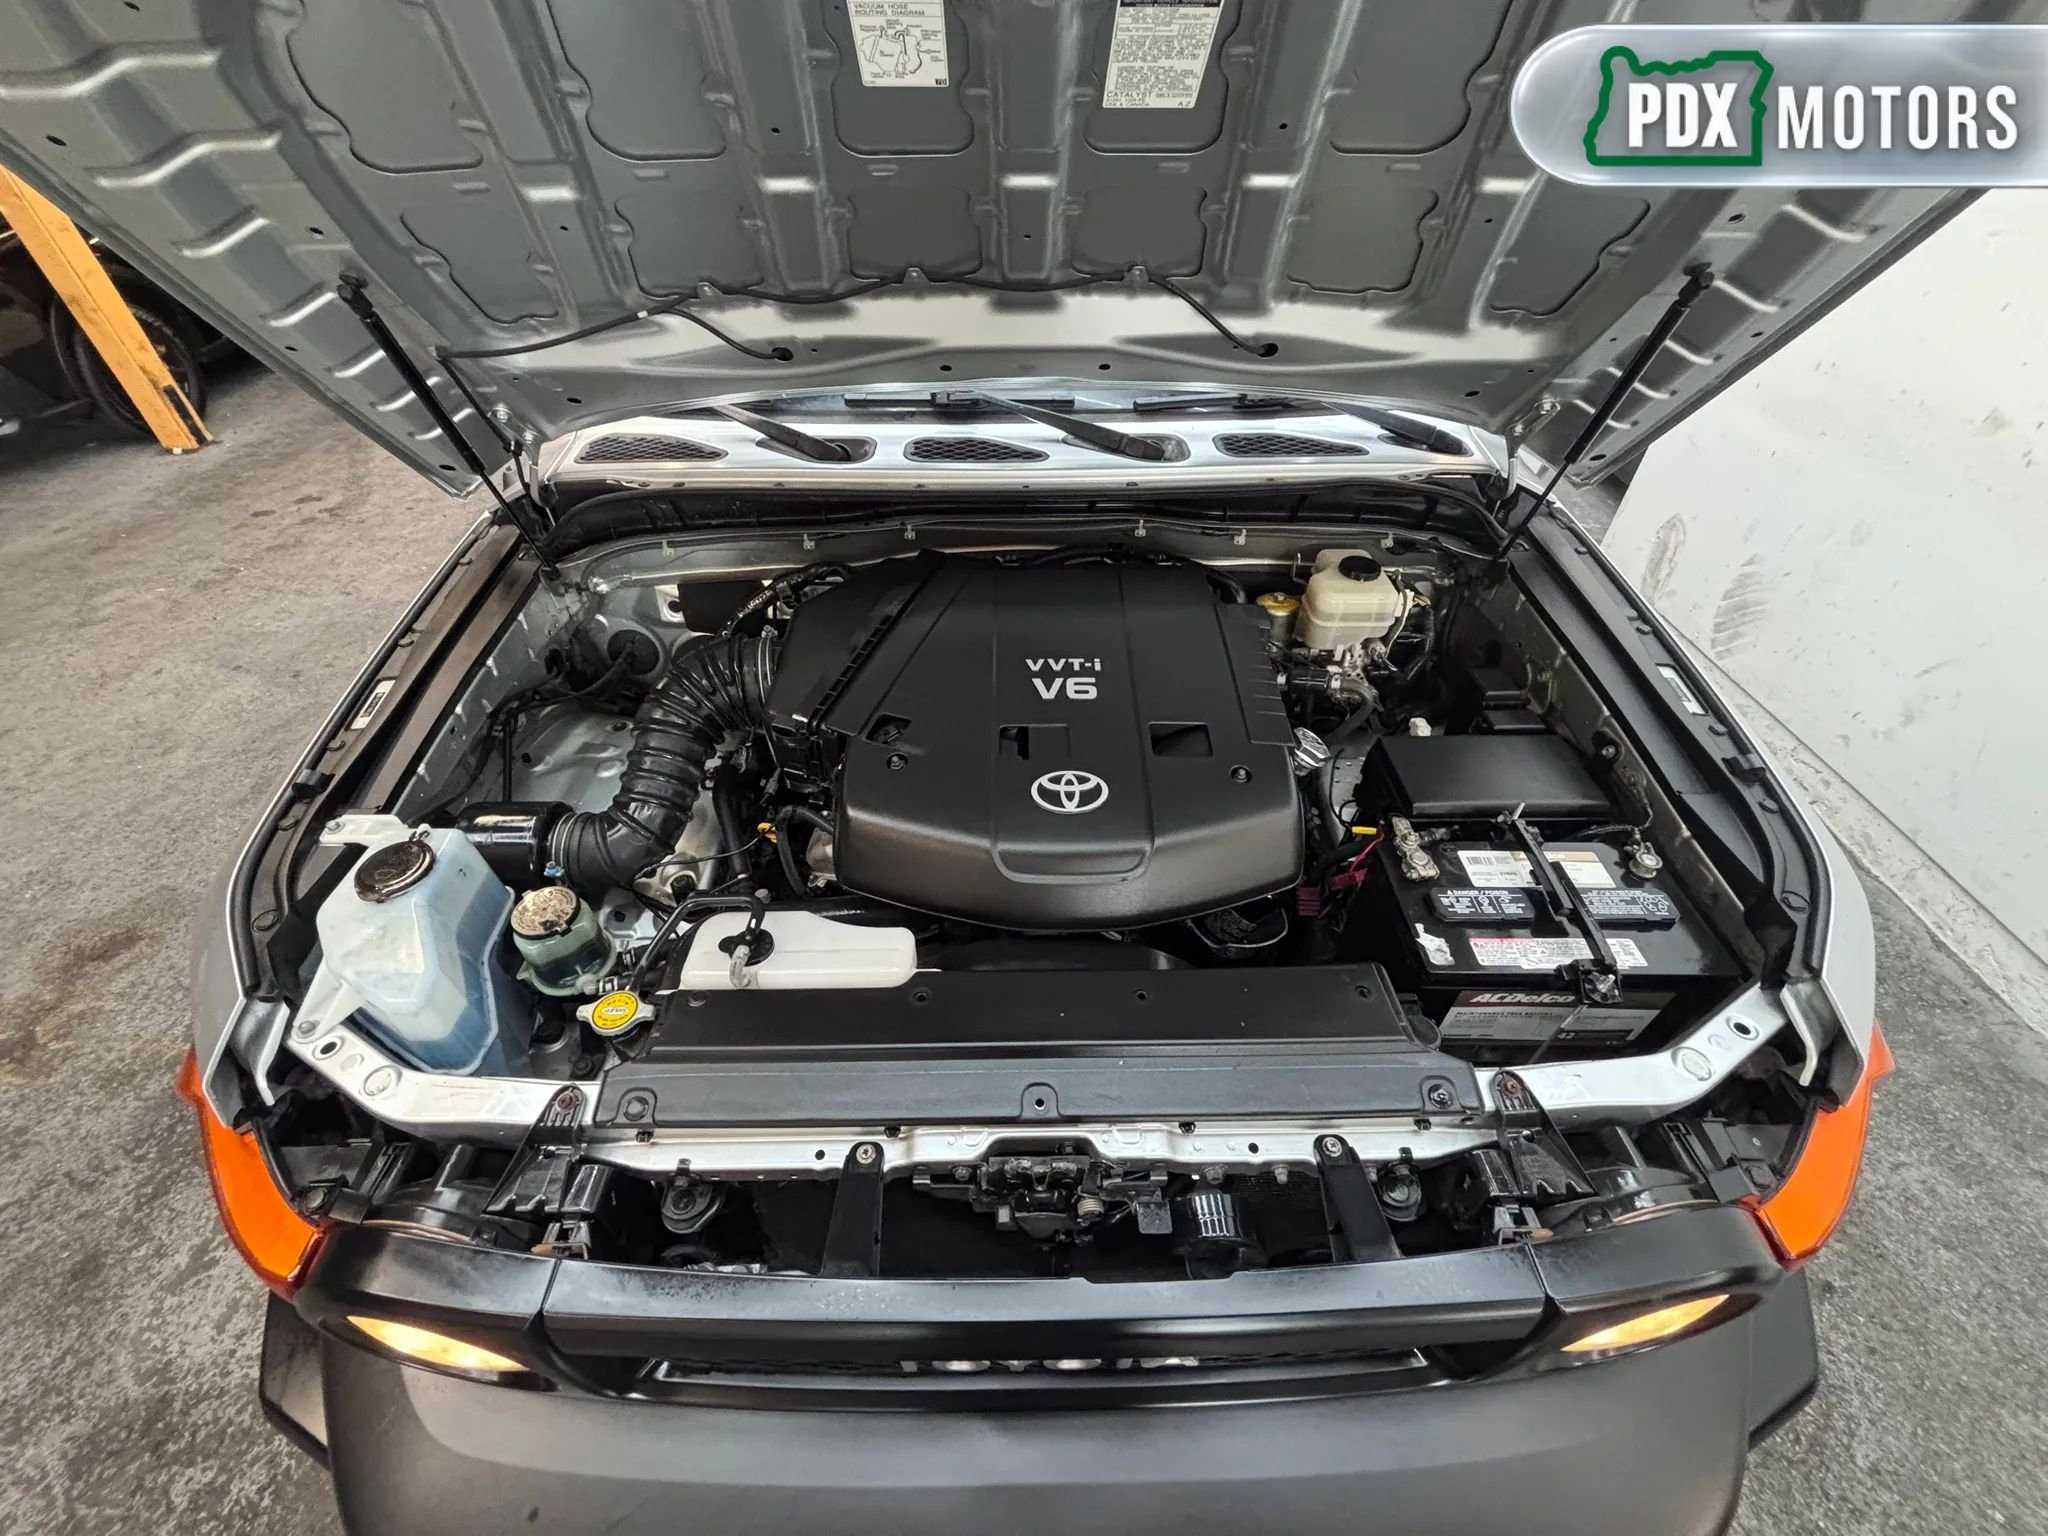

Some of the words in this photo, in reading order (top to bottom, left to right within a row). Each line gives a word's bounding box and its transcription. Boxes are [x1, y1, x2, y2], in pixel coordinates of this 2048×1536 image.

[1025, 658, 1102, 672] VVT-i
[1031, 677, 1098, 700] V6
[1469, 993, 1576, 1003] ACDelco
